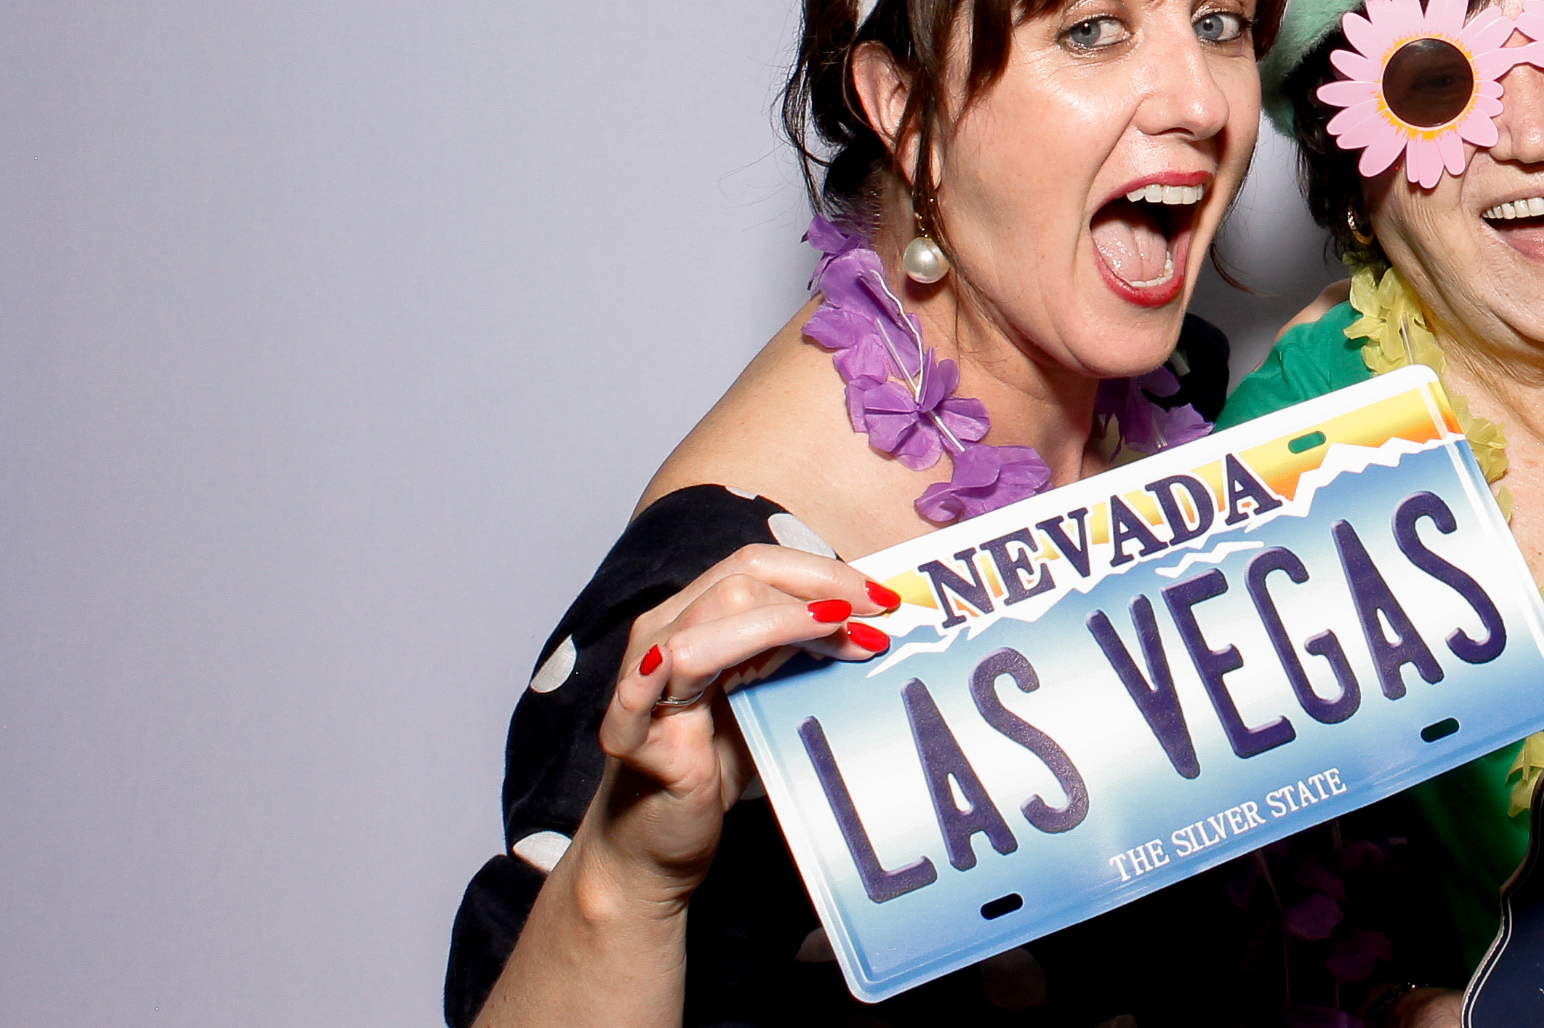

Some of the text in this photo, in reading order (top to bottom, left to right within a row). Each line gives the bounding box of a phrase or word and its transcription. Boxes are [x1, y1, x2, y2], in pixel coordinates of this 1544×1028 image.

[917, 452, 1284, 630] NEVADA
[796, 490, 1508, 905] LAS VEGAS
[1109, 767, 1348, 883] THE SILVER STATE
